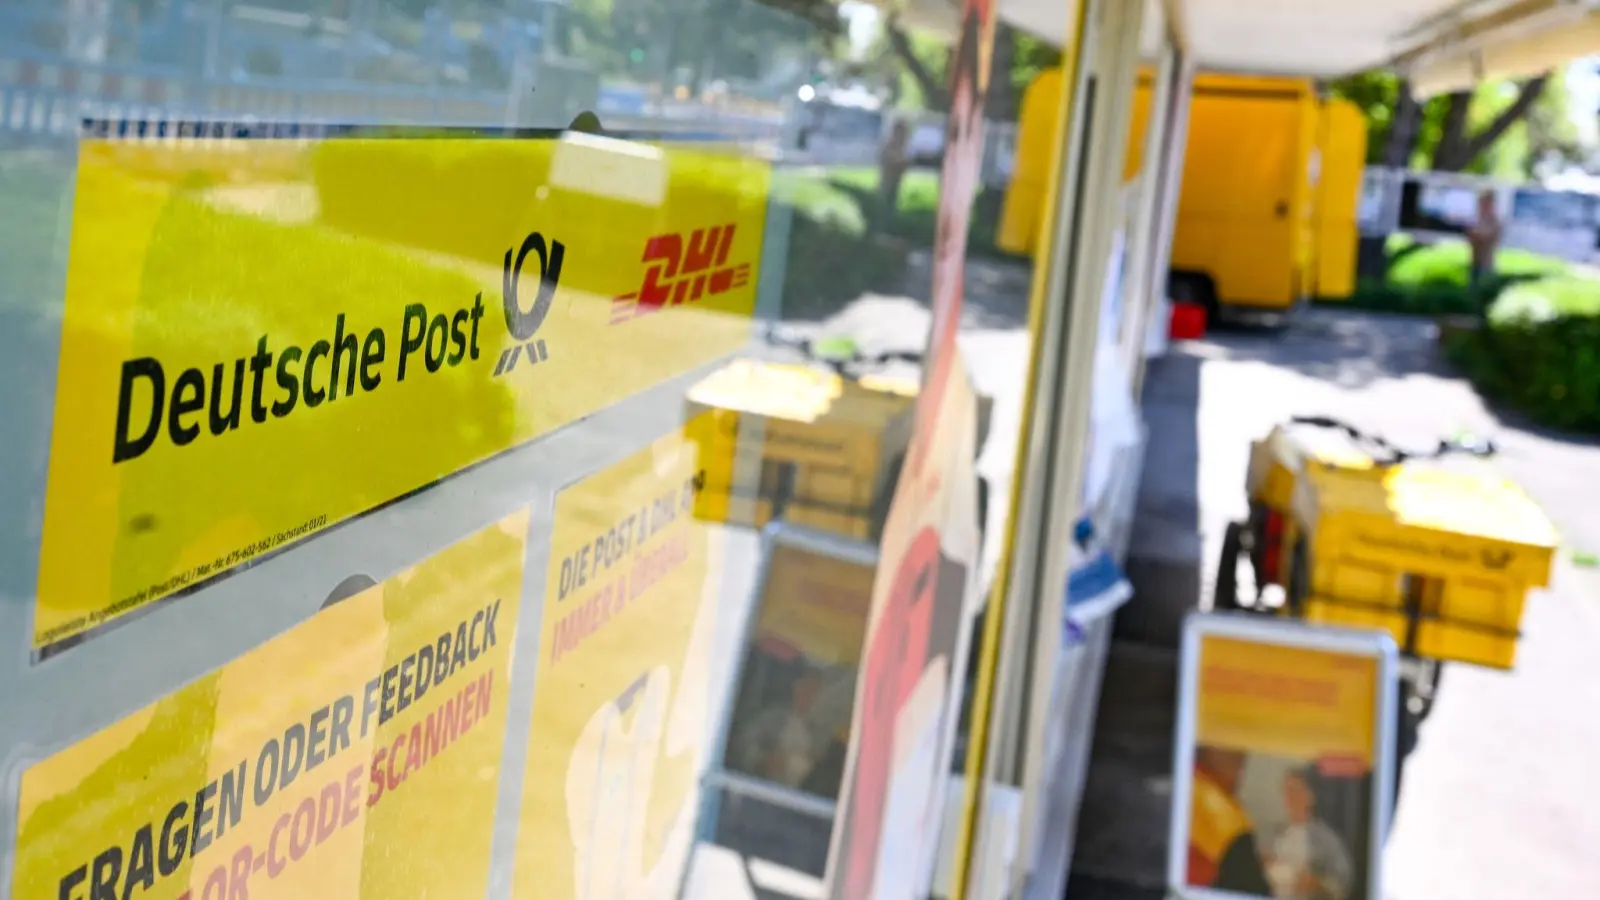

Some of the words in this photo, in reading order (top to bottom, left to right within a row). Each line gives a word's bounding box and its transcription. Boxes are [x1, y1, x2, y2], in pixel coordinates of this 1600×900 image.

[633, 223, 737, 316] DHL
[112, 313, 386, 465] Deutsche
[397, 292, 484, 382] Post
[226, 537, 271, 565] 675-602-562
[309, 513, 327, 530] 01/21
[558, 542, 591, 602] DIE
[592, 512, 636, 578] POST
[254, 695, 355, 806] ODER
[360, 598, 501, 739] FEEDBACK
[366, 667, 494, 807] SCANNEN
